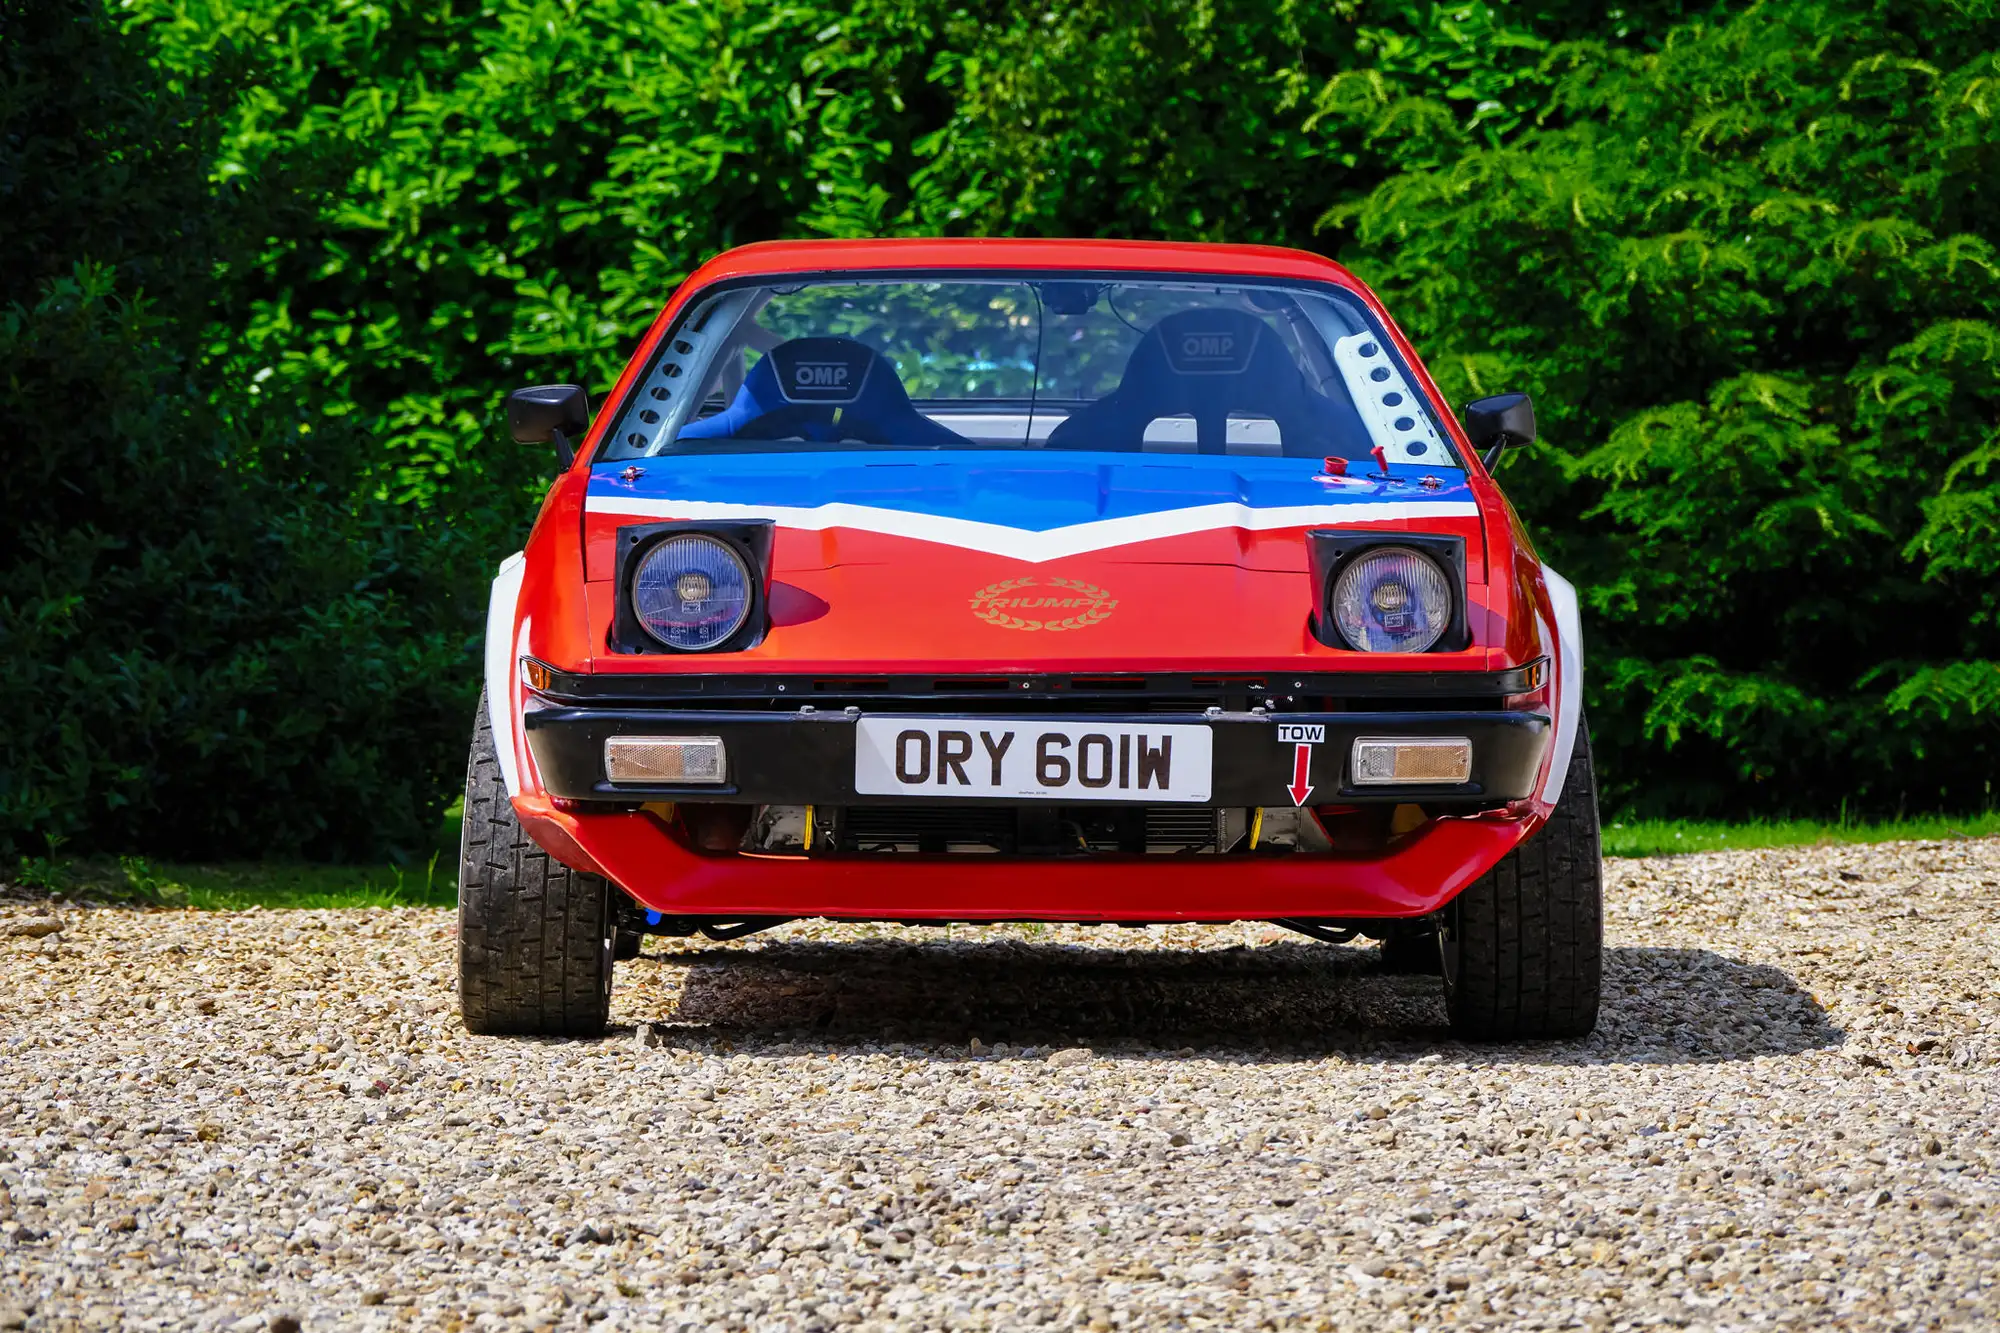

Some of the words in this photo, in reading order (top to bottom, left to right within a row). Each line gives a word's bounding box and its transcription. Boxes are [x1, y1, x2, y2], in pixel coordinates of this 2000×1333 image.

[1183, 337, 1234, 356] OMP
[796, 366, 848, 385] OMP
[968, 597, 1119, 609] TRIUMPH
[1279, 726, 1323, 740] TOW
[895, 729, 1015, 786] ORY
[1035, 732, 1173, 790] 601W
